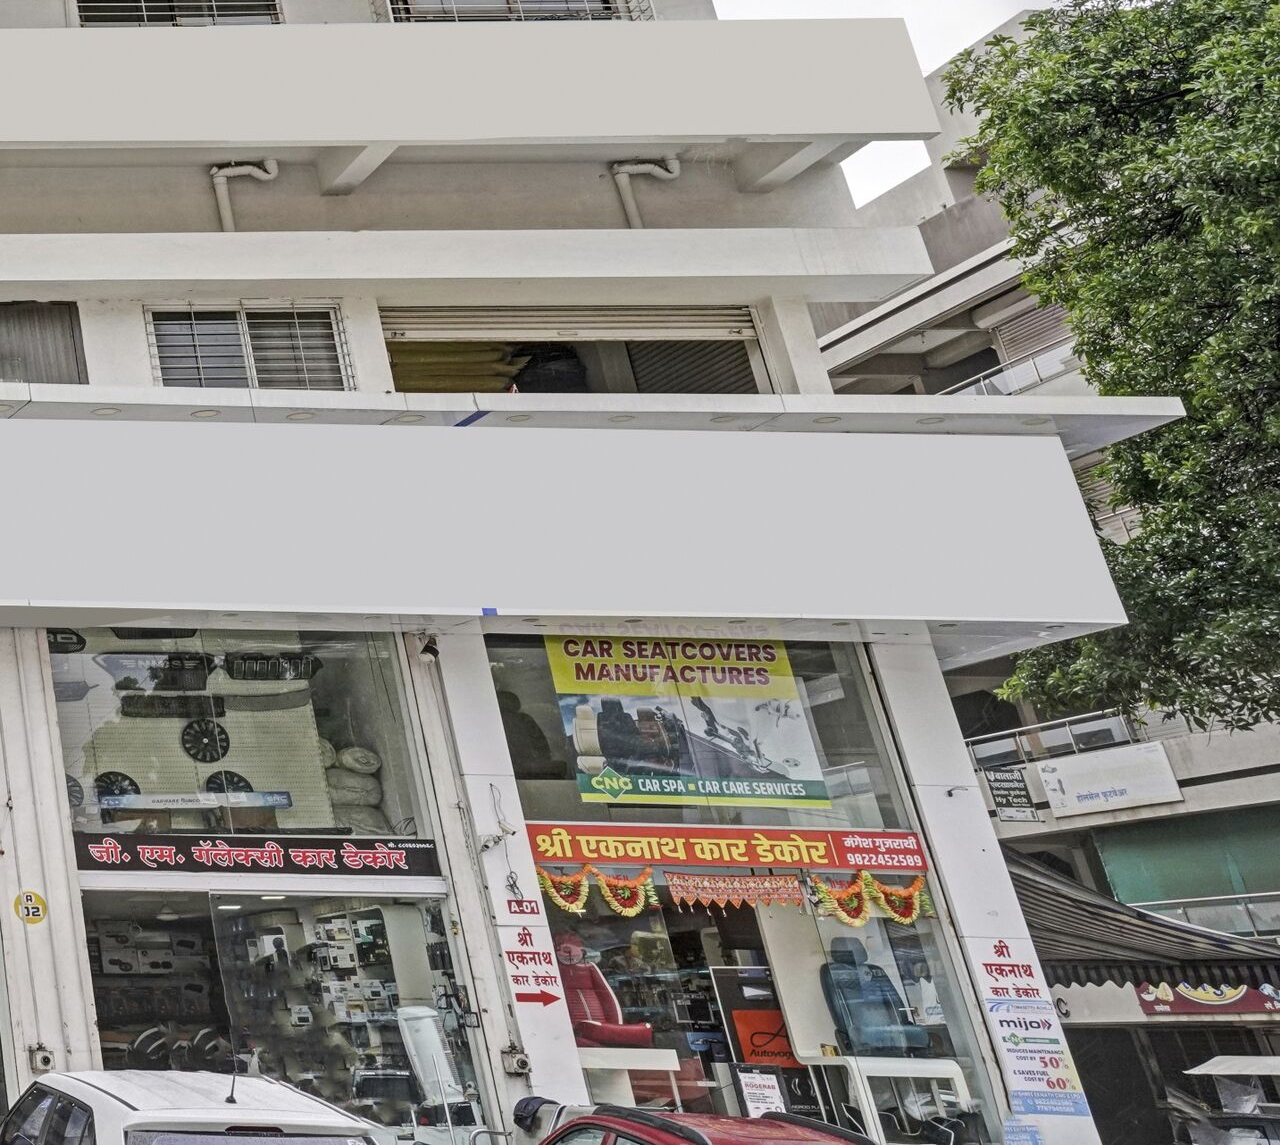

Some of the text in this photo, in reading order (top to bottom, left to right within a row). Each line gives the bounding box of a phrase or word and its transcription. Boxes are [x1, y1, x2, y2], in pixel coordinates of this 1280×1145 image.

[563, 639, 777, 663] CAR SEATCOVERS
[574, 662, 770, 685] MANUFACTURES
[591, 775, 806, 796] CNG CAR SPA CAR CARE SERVICES
[535, 828, 829, 865] श्री एकनाथ कार डेकोर
[842, 835, 918, 853] मंगेश गुजराथी
[192, 839, 284, 869] गॅलेक्सी
[291, 849, 336, 870] कार
[340, 842, 408, 870] डेकोर
[846, 854, 922, 868] 9822452589
[25, 895, 33, 903] A
[510, 902, 539, 914] A-01
[518, 927, 534, 947] श्री
[993, 940, 1011, 959] श्री
[505, 951, 553, 970] एकनाथ
[511, 971, 560, 987] कार डेकोर
[982, 963, 1035, 982] एकनाथ
[990, 984, 1042, 999] कार डेकोर
[999, 1017, 1041, 1031] mijo
[749, 1049, 793, 1059] Autovog
